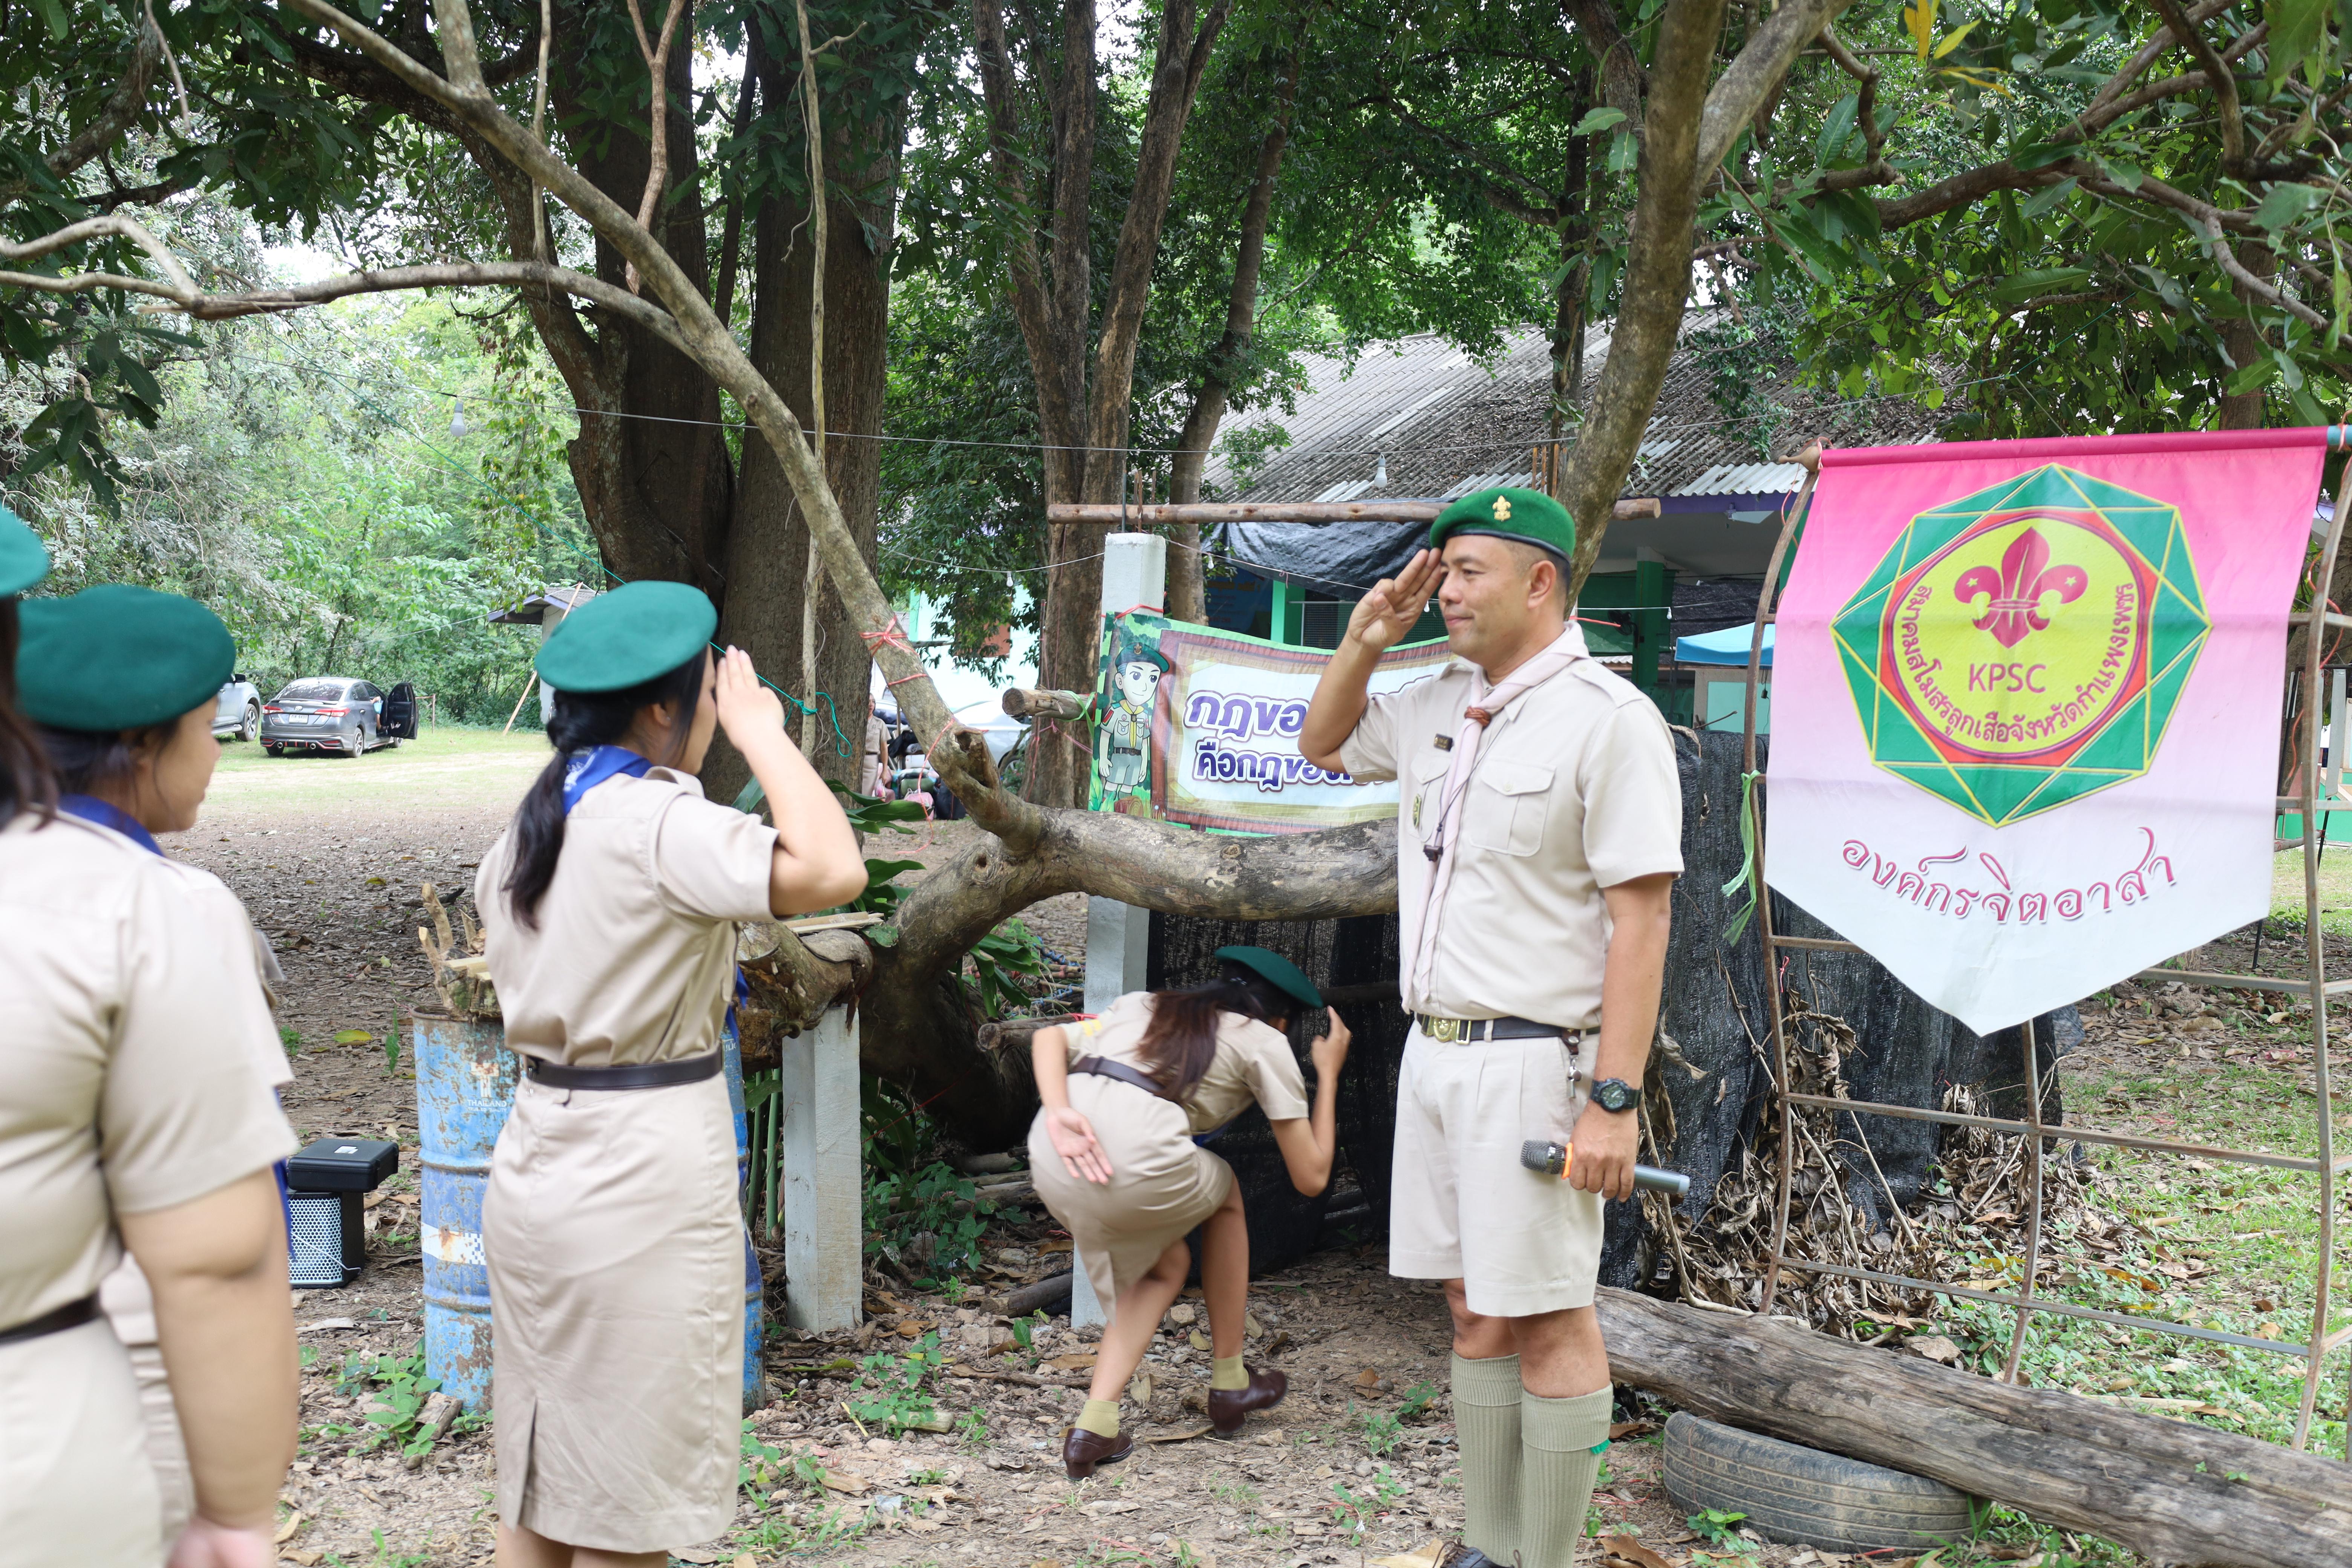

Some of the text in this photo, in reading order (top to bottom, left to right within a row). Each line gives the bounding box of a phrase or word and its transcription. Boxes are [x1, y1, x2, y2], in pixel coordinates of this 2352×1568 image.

[1901, 583, 2135, 743] สมาคมสโมสรลูกเสือจังหวัดกำแพงเพชร
[1969, 662, 2047, 693] KPSC
[1187, 694, 1307, 738] กฎขอ
[1842, 825, 2176, 922] องค์กรจิตอาสา
